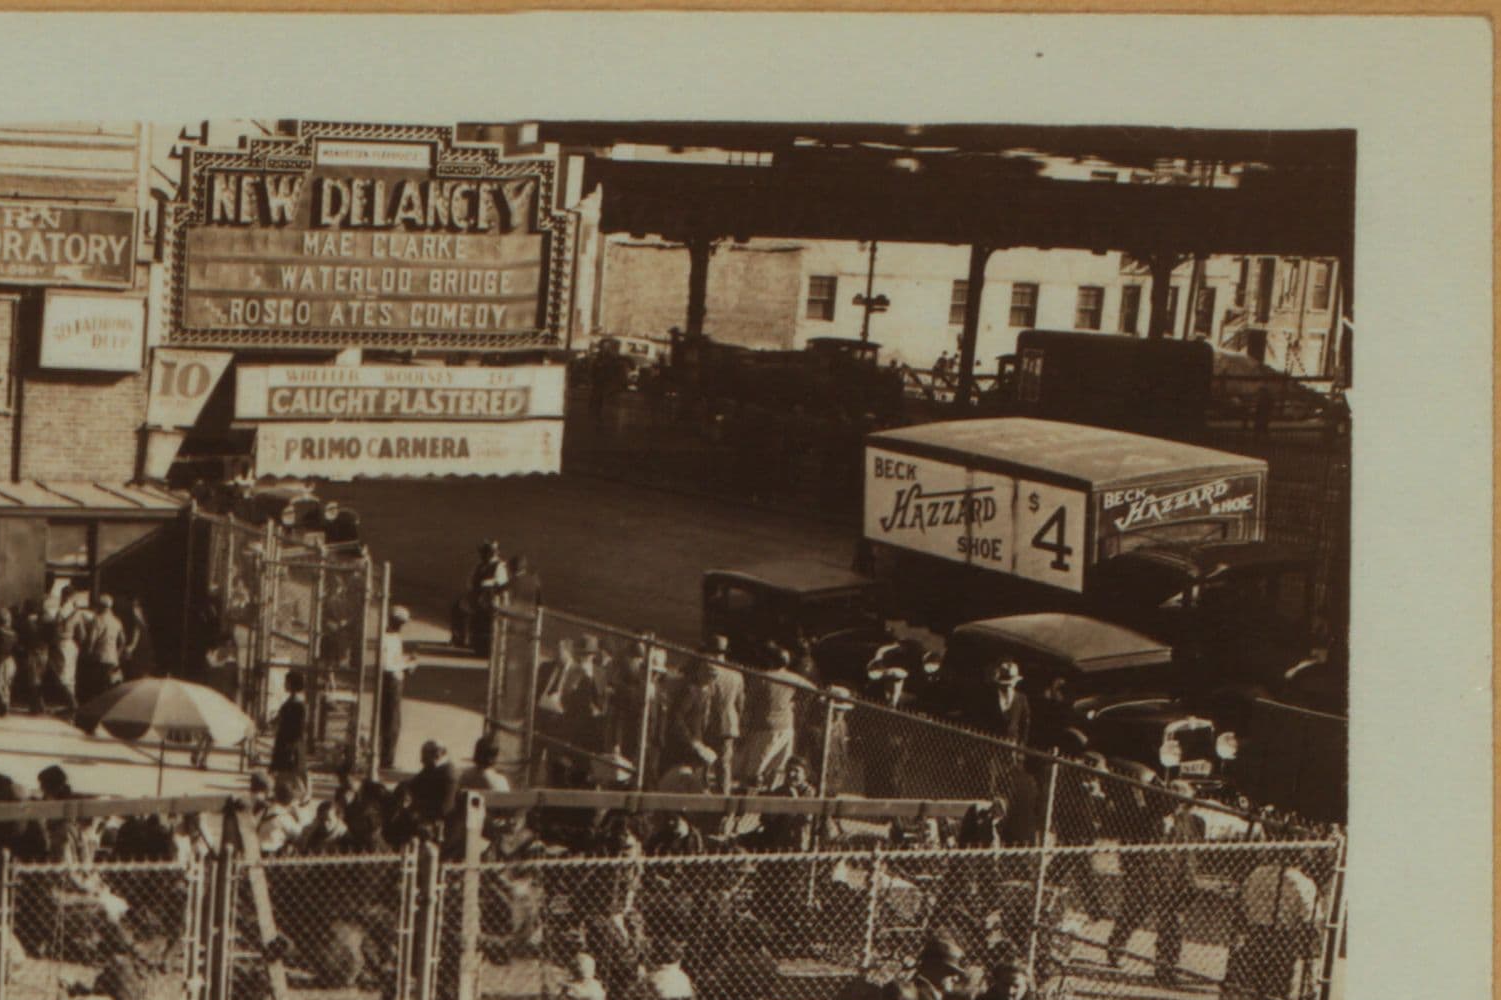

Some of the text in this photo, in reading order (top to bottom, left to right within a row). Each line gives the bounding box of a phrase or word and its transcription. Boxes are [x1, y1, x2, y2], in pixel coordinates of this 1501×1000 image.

[211, 172, 535, 230] NEW DELANCEY
[303, 231, 469, 261] MAE CLARKE
[281, 265, 513, 296] WATERLOO BRIDGE
[230, 299, 508, 328] ROSCO ATES COMEDY
[160, 360, 212, 400] 10
[272, 388, 527, 415] CAUGHT PLASTERED
[285, 437, 361, 461] PRIMO
[366, 437, 470, 459] CARNERA
[874, 456, 917, 481] BECK
[879, 483, 997, 535] HAZZARD
[1103, 487, 1148, 510] BECK
[1114, 478, 1230, 532] HAZZARD
[957, 535, 1003, 562] SHOE
